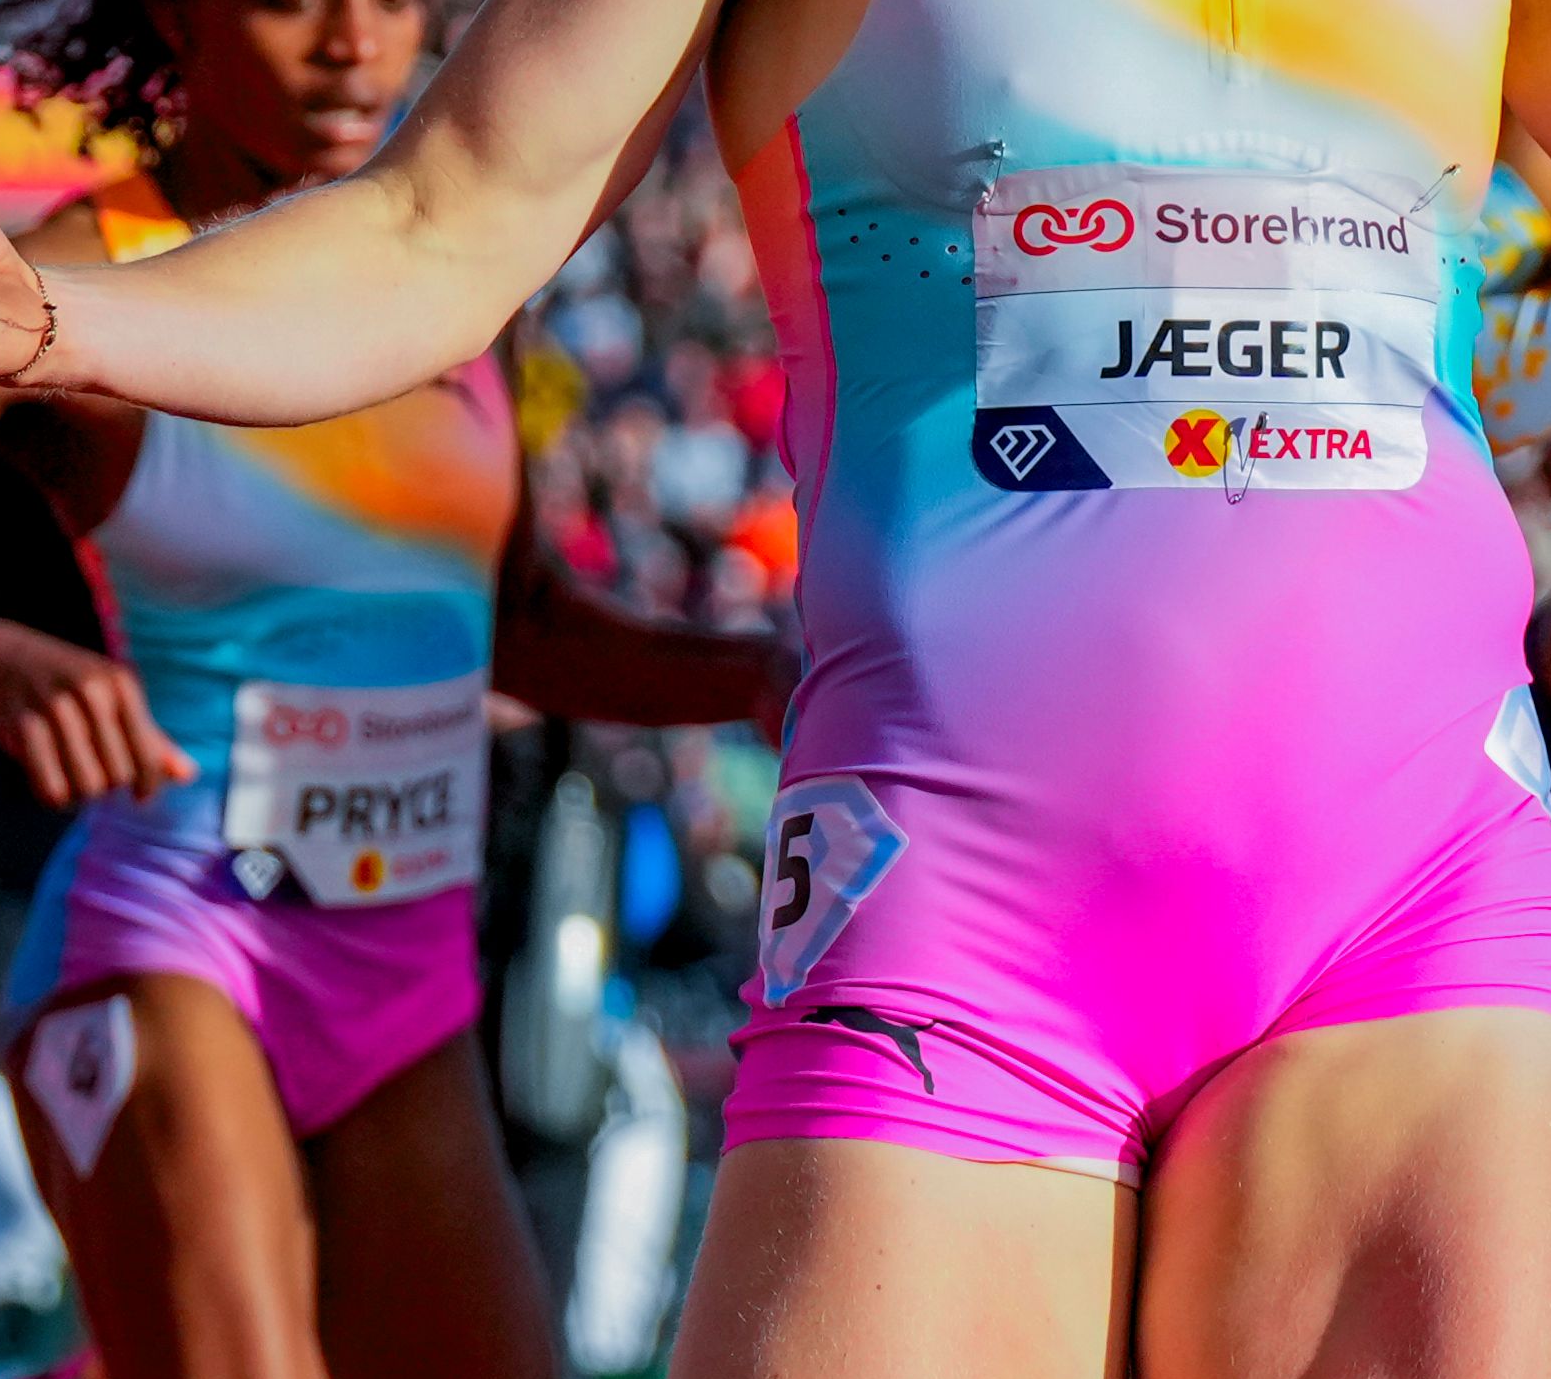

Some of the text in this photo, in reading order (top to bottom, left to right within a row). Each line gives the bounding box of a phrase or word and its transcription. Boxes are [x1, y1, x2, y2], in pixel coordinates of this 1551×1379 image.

[1154, 202, 1411, 255] Storebrand
[1099, 319, 1351, 380] JÆGER
[1248, 428, 1373, 461] EXTRA
[295, 770, 453, 838] PRYCE
[771, 812, 815, 931] 5
